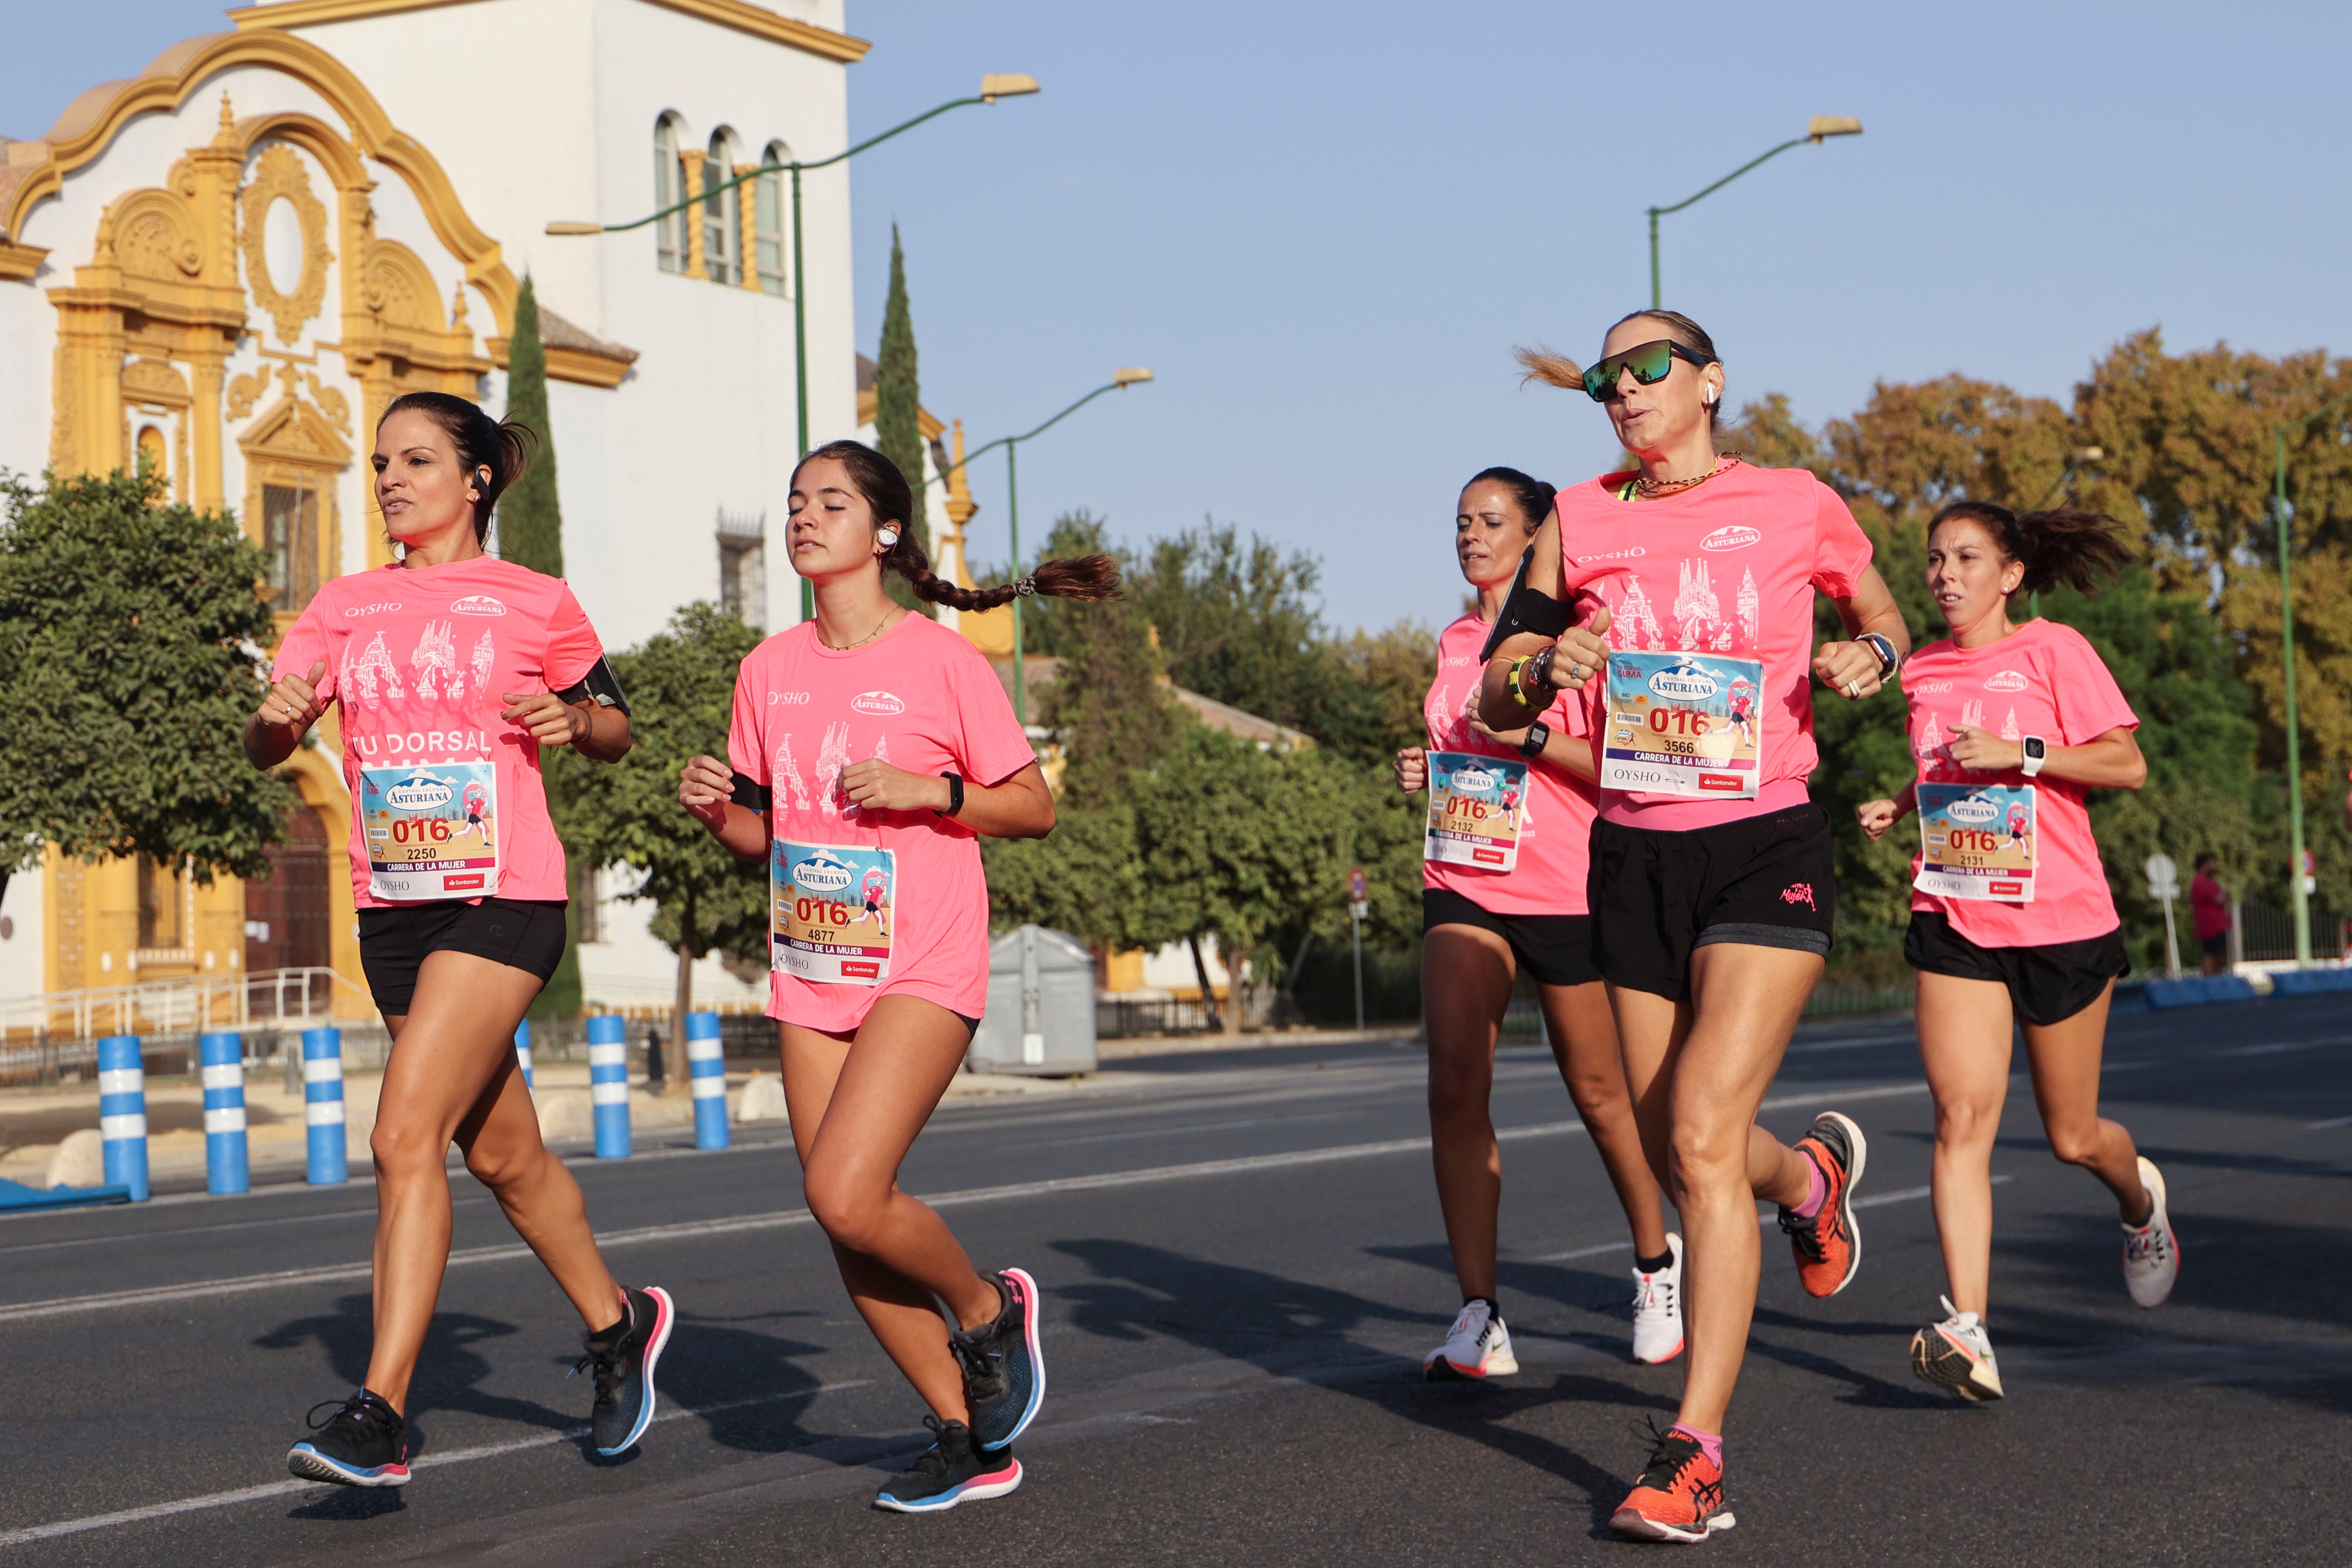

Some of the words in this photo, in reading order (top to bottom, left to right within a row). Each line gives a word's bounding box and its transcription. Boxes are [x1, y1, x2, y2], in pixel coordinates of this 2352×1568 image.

[1705, 535, 1756, 548] ASTURIANA
[1577, 547, 1645, 563] OYSHO
[346, 603, 402, 617] OYSHO
[454, 603, 502, 614] ASTURIANA
[1617, 670, 1642, 678] SUMA
[1652, 677, 1712, 694] ASTURIANA
[1915, 682, 1953, 696] OYSHO
[854, 698, 899, 711] ASTURIANA
[1650, 708, 1711, 736] 016
[352, 735, 378, 755] TU
[387, 731, 492, 753] DORSAL
[1664, 740, 1693, 754] 3566
[1634, 752, 1670, 763] CARRERA
[1672, 755, 1682, 764] DE
[1684, 757, 1692, 765] LA
[1695, 758, 1723, 767] MUJER
[1454, 772, 1491, 787] ASTURIANA
[1614, 769, 1660, 783] OYSHO
[390, 791, 448, 803] ASTURIANA
[1447, 796, 1487, 819] 016
[1951, 805, 1995, 817] ASTURIANA
[393, 818, 450, 843] 016
[1451, 821, 1473, 832] 2132
[1472, 835, 1492, 845] MUJER
[1950, 829, 1996, 851] 016
[407, 848, 436, 860] 2250
[1961, 855, 1983, 866] 2131
[439, 861, 465, 869] MUJER
[1942, 866, 1965, 874] CARRERA
[796, 867, 847, 885] ASTURIANA
[381, 880, 409, 890] OYSHO
[1928, 879, 1960, 890] OYSHO
[1779, 888, 1804, 904] Mujer
[797, 898, 848, 925] 016
[808, 929, 834, 942] 4877
[790, 939, 813, 951] CARRERA
[815, 944, 824, 952] DE
[837, 947, 862, 955] MUJER
[781, 953, 808, 969] OYSHO
